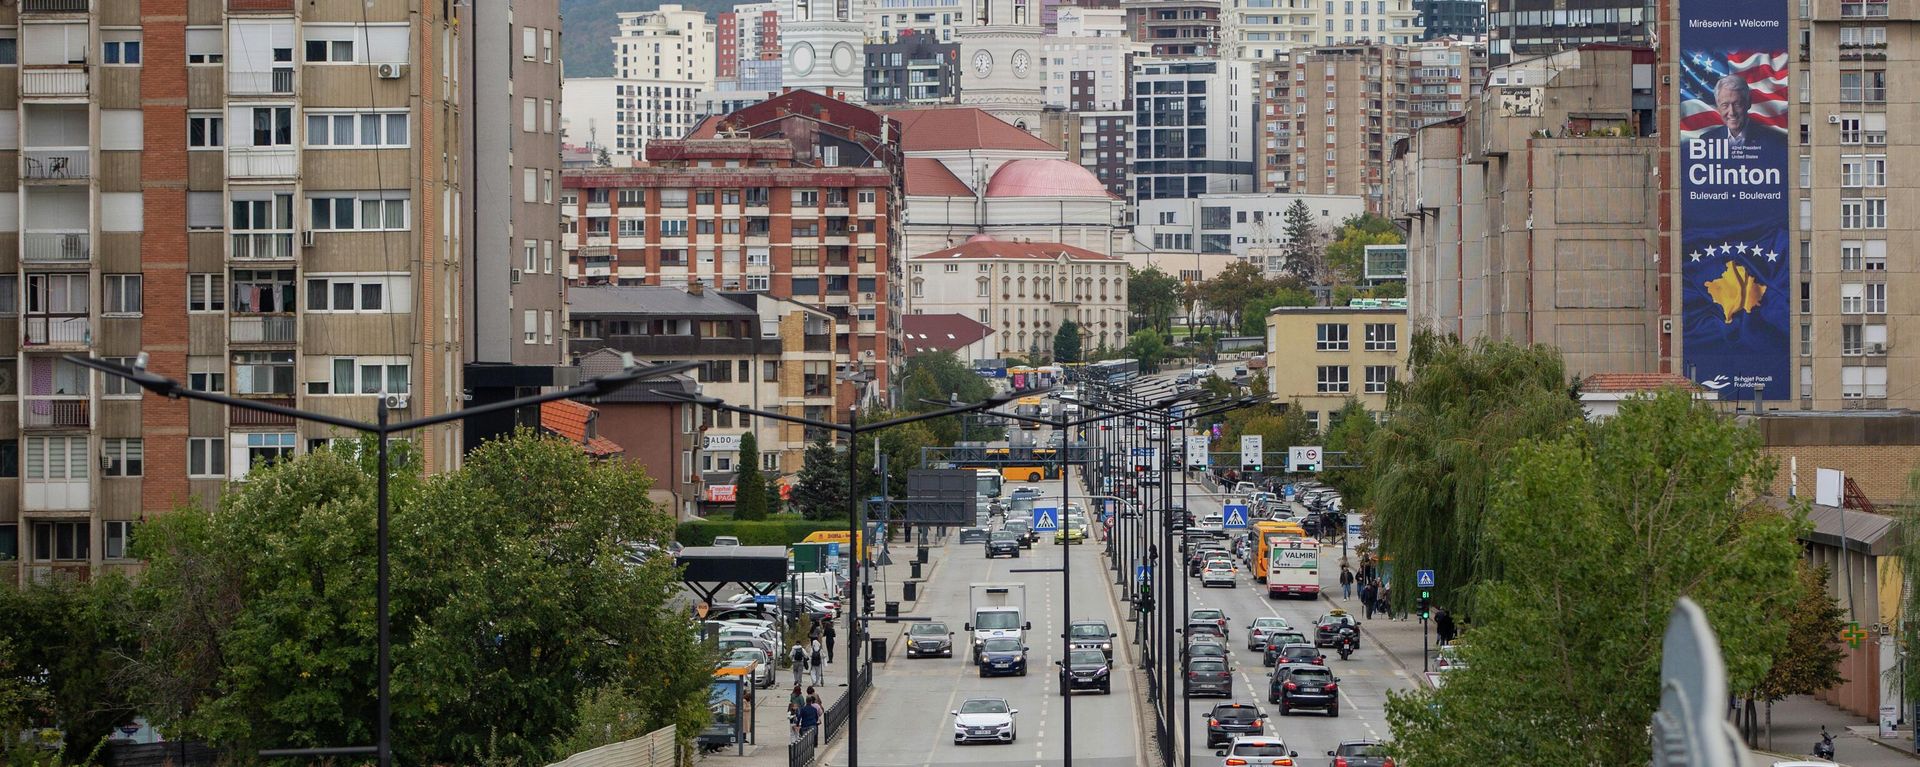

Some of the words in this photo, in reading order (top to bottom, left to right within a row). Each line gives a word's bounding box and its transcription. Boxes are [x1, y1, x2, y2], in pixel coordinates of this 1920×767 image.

[1689, 19, 1732, 28] Mirësevini
[1739, 19, 1779, 28] Welcome
[1689, 138, 1729, 159] Bill
[1689, 163, 1780, 185] Clinton
[1690, 191, 1729, 200] Bulevardi
[1739, 191, 1781, 200] Boulevard
[711, 436, 731, 444] ALDO
[1285, 550, 1316, 559] VALMIRI
